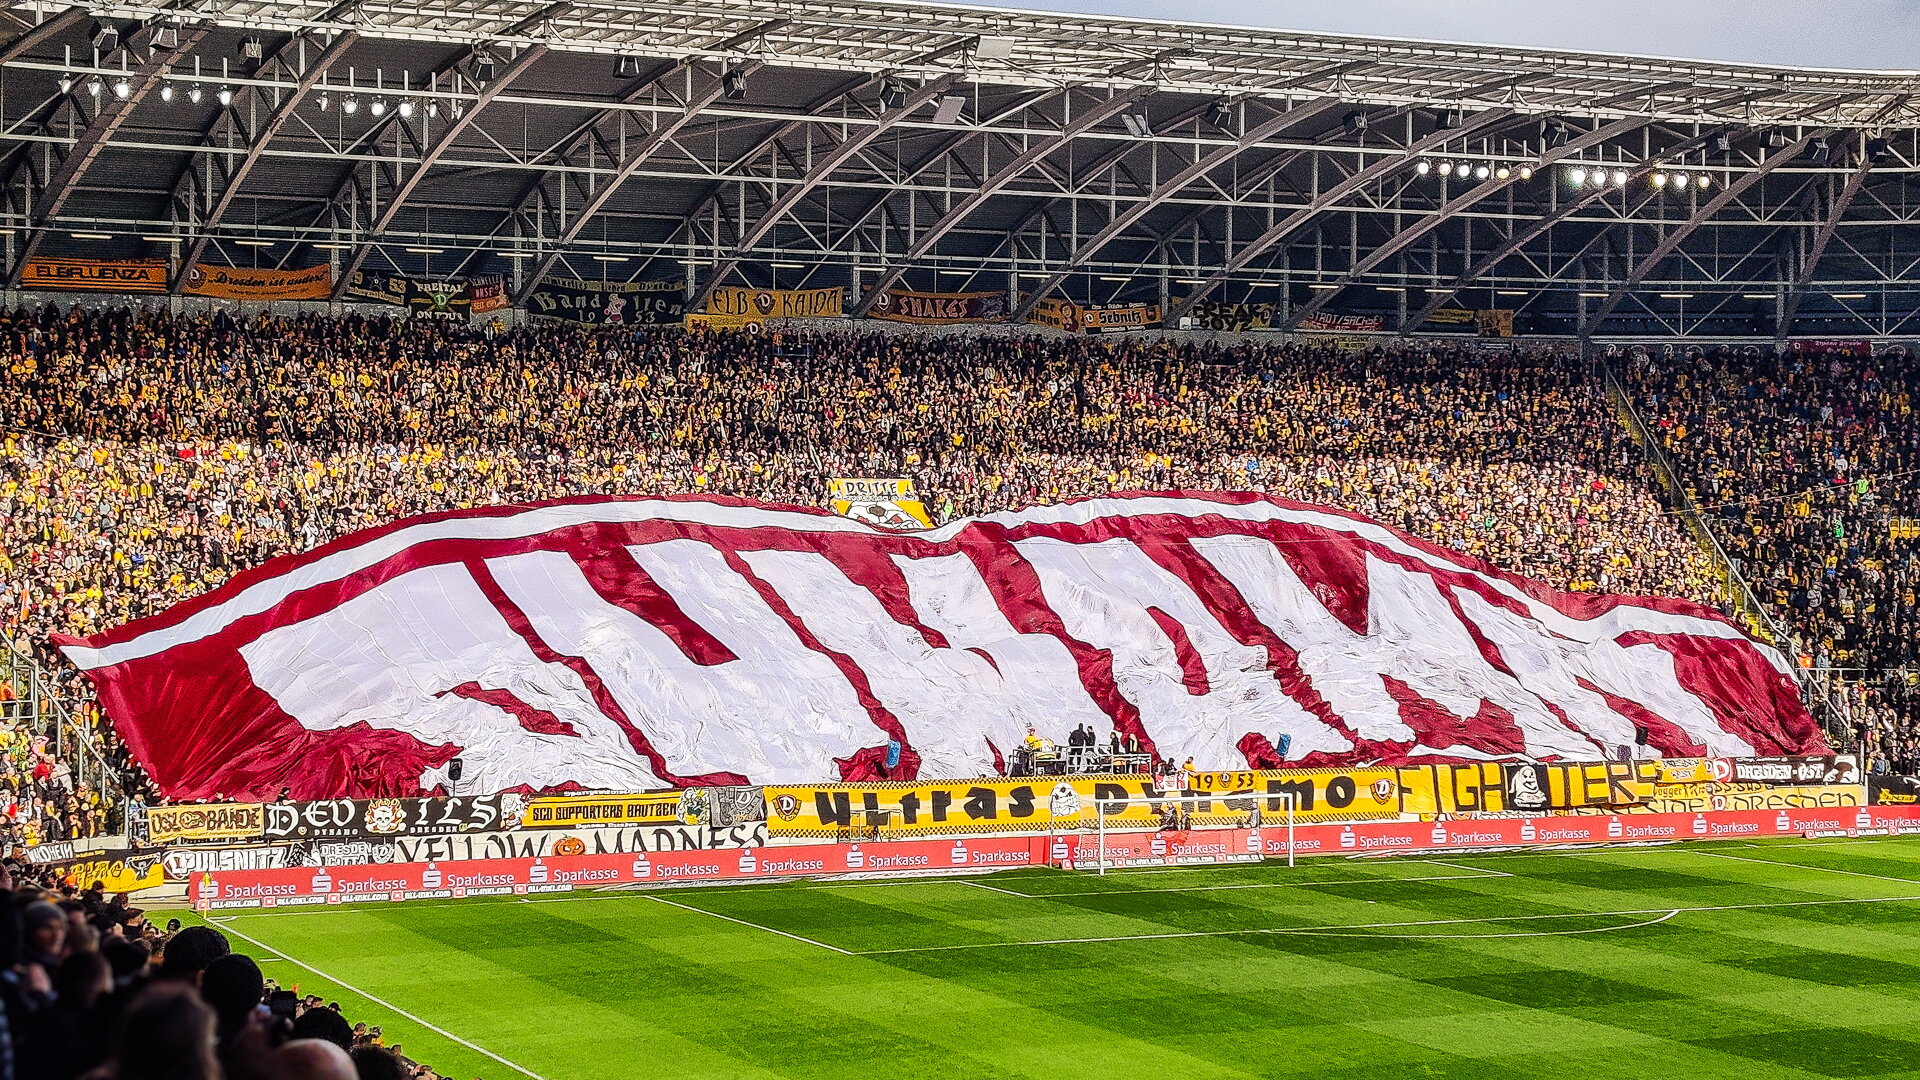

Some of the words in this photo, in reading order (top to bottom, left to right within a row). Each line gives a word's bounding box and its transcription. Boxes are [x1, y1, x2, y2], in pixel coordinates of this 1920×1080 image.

[417, 282, 464, 293] FREITAL
[782, 289, 838, 316] KAIDA
[416, 311, 432, 320] ON
[634, 310, 656, 324] 53
[845, 481, 897, 494] DRITTE
[1194, 774, 1213, 789] 19
[1237, 773, 1255, 789] 53
[1733, 792, 1857, 812] DRESDEN
[556, 804, 623, 820] SUPPORTERS
[627, 802, 678, 817] BAUTZEN
[207, 807, 262, 831] BANDE
[1794, 818, 1840, 831] Sparkasse
[314, 828, 358, 836] DYNAMO
[410, 825, 457, 834] DRESDEN
[1540, 828, 1590, 843] Sparkasse
[1627, 824, 1675, 837] Sparkasse
[1711, 821, 1759, 835] Sparkasse
[396, 832, 549, 863] YELLOW
[594, 822, 767, 855] MADNESS
[1360, 834, 1412, 848] Sparkasse
[1451, 831, 1502, 846] Sparkasse
[321, 842, 372, 857] DRESDEN
[972, 849, 1030, 864] Sparkasse
[1172, 842, 1226, 856] Sparkasse
[182, 847, 287, 872] PULSNITZ
[325, 854, 368, 866] COTTA
[762, 857, 823, 873] Sparkasse
[869, 853, 928, 868] Sparkasse
[554, 866, 619, 884] Sparkasse
[656, 862, 720, 878] Sparkasse
[338, 877, 407, 894] Sparkasse
[448, 871, 515, 888] Sparkasse
[225, 882, 296, 898] Sparkasse
